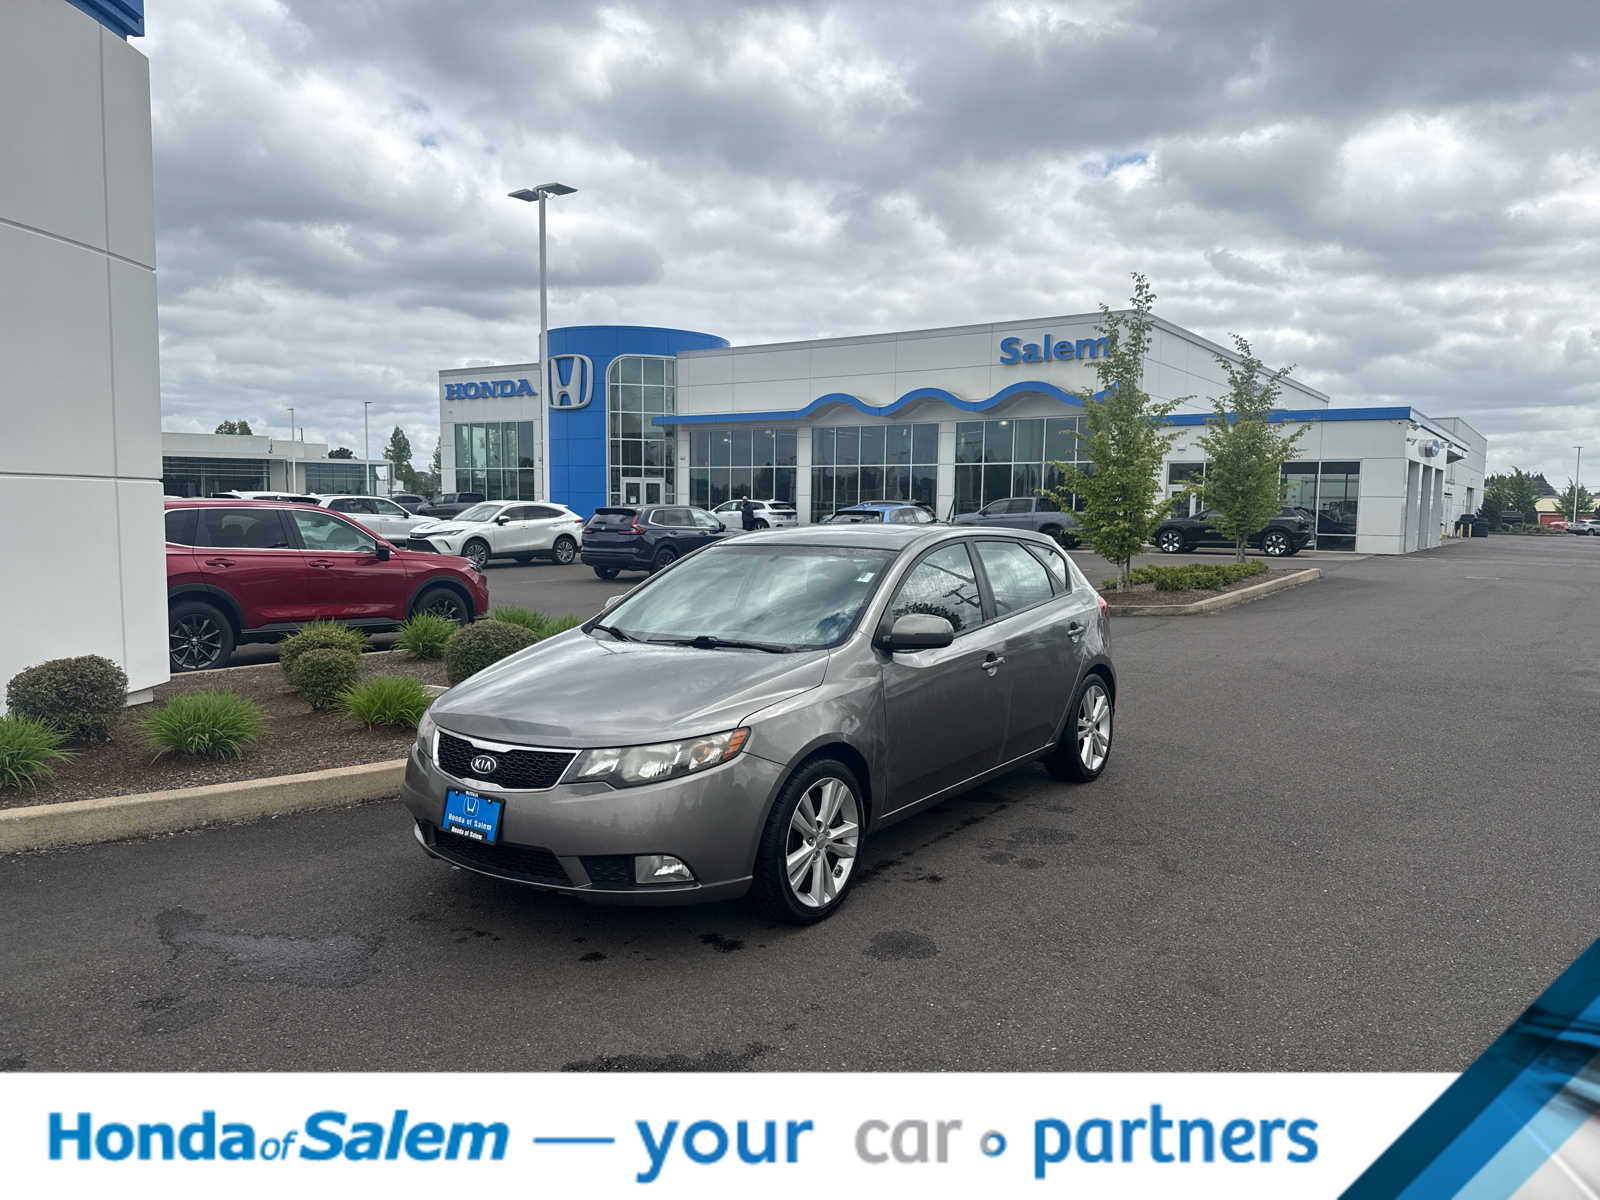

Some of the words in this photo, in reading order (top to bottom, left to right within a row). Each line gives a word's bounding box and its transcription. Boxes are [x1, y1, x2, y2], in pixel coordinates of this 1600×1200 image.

[999, 333, 1111, 365] Salem
[444, 378, 538, 401] HONDA
[474, 758, 491, 771] KIA
[448, 813, 465, 824] Honda
[474, 820, 492, 832] Salem
